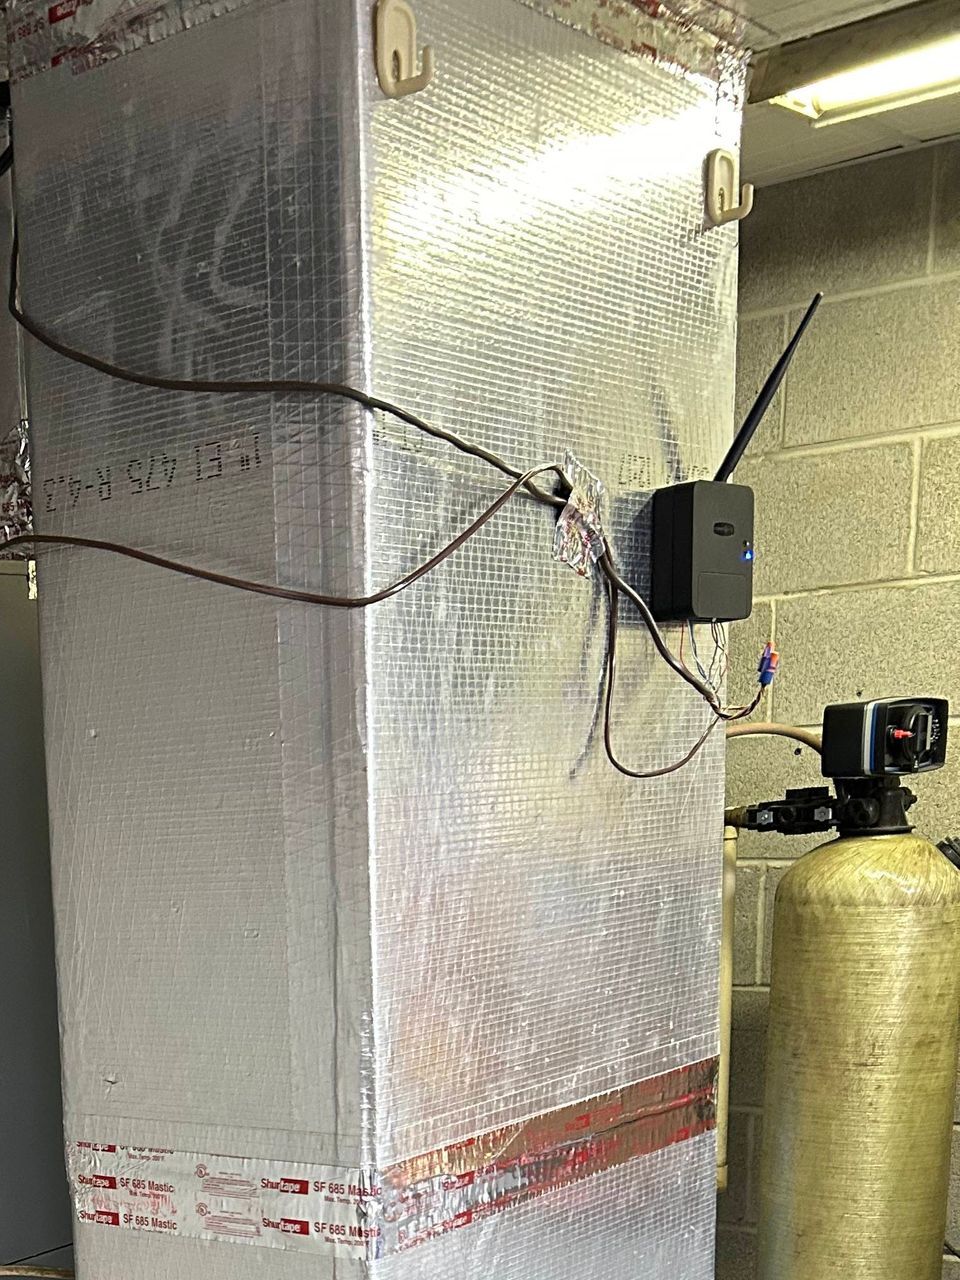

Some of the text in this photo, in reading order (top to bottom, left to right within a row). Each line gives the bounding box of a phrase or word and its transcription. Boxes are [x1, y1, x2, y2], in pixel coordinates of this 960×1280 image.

[127, 453, 177, 495] 475
[78, 1174, 175, 1193] Shurtape SF 685 Mastic
[260, 1178, 302, 1194] Shurtape
[313, 1181, 326, 1193] SF
[328, 1183, 345, 1195] 685
[79, 1210, 178, 1230] Shurtape SF 685 Mastic
[262, 1218, 303, 1235] Shurtape
[314, 1221, 327, 1233] SF
[329, 1223, 346, 1236] 685
